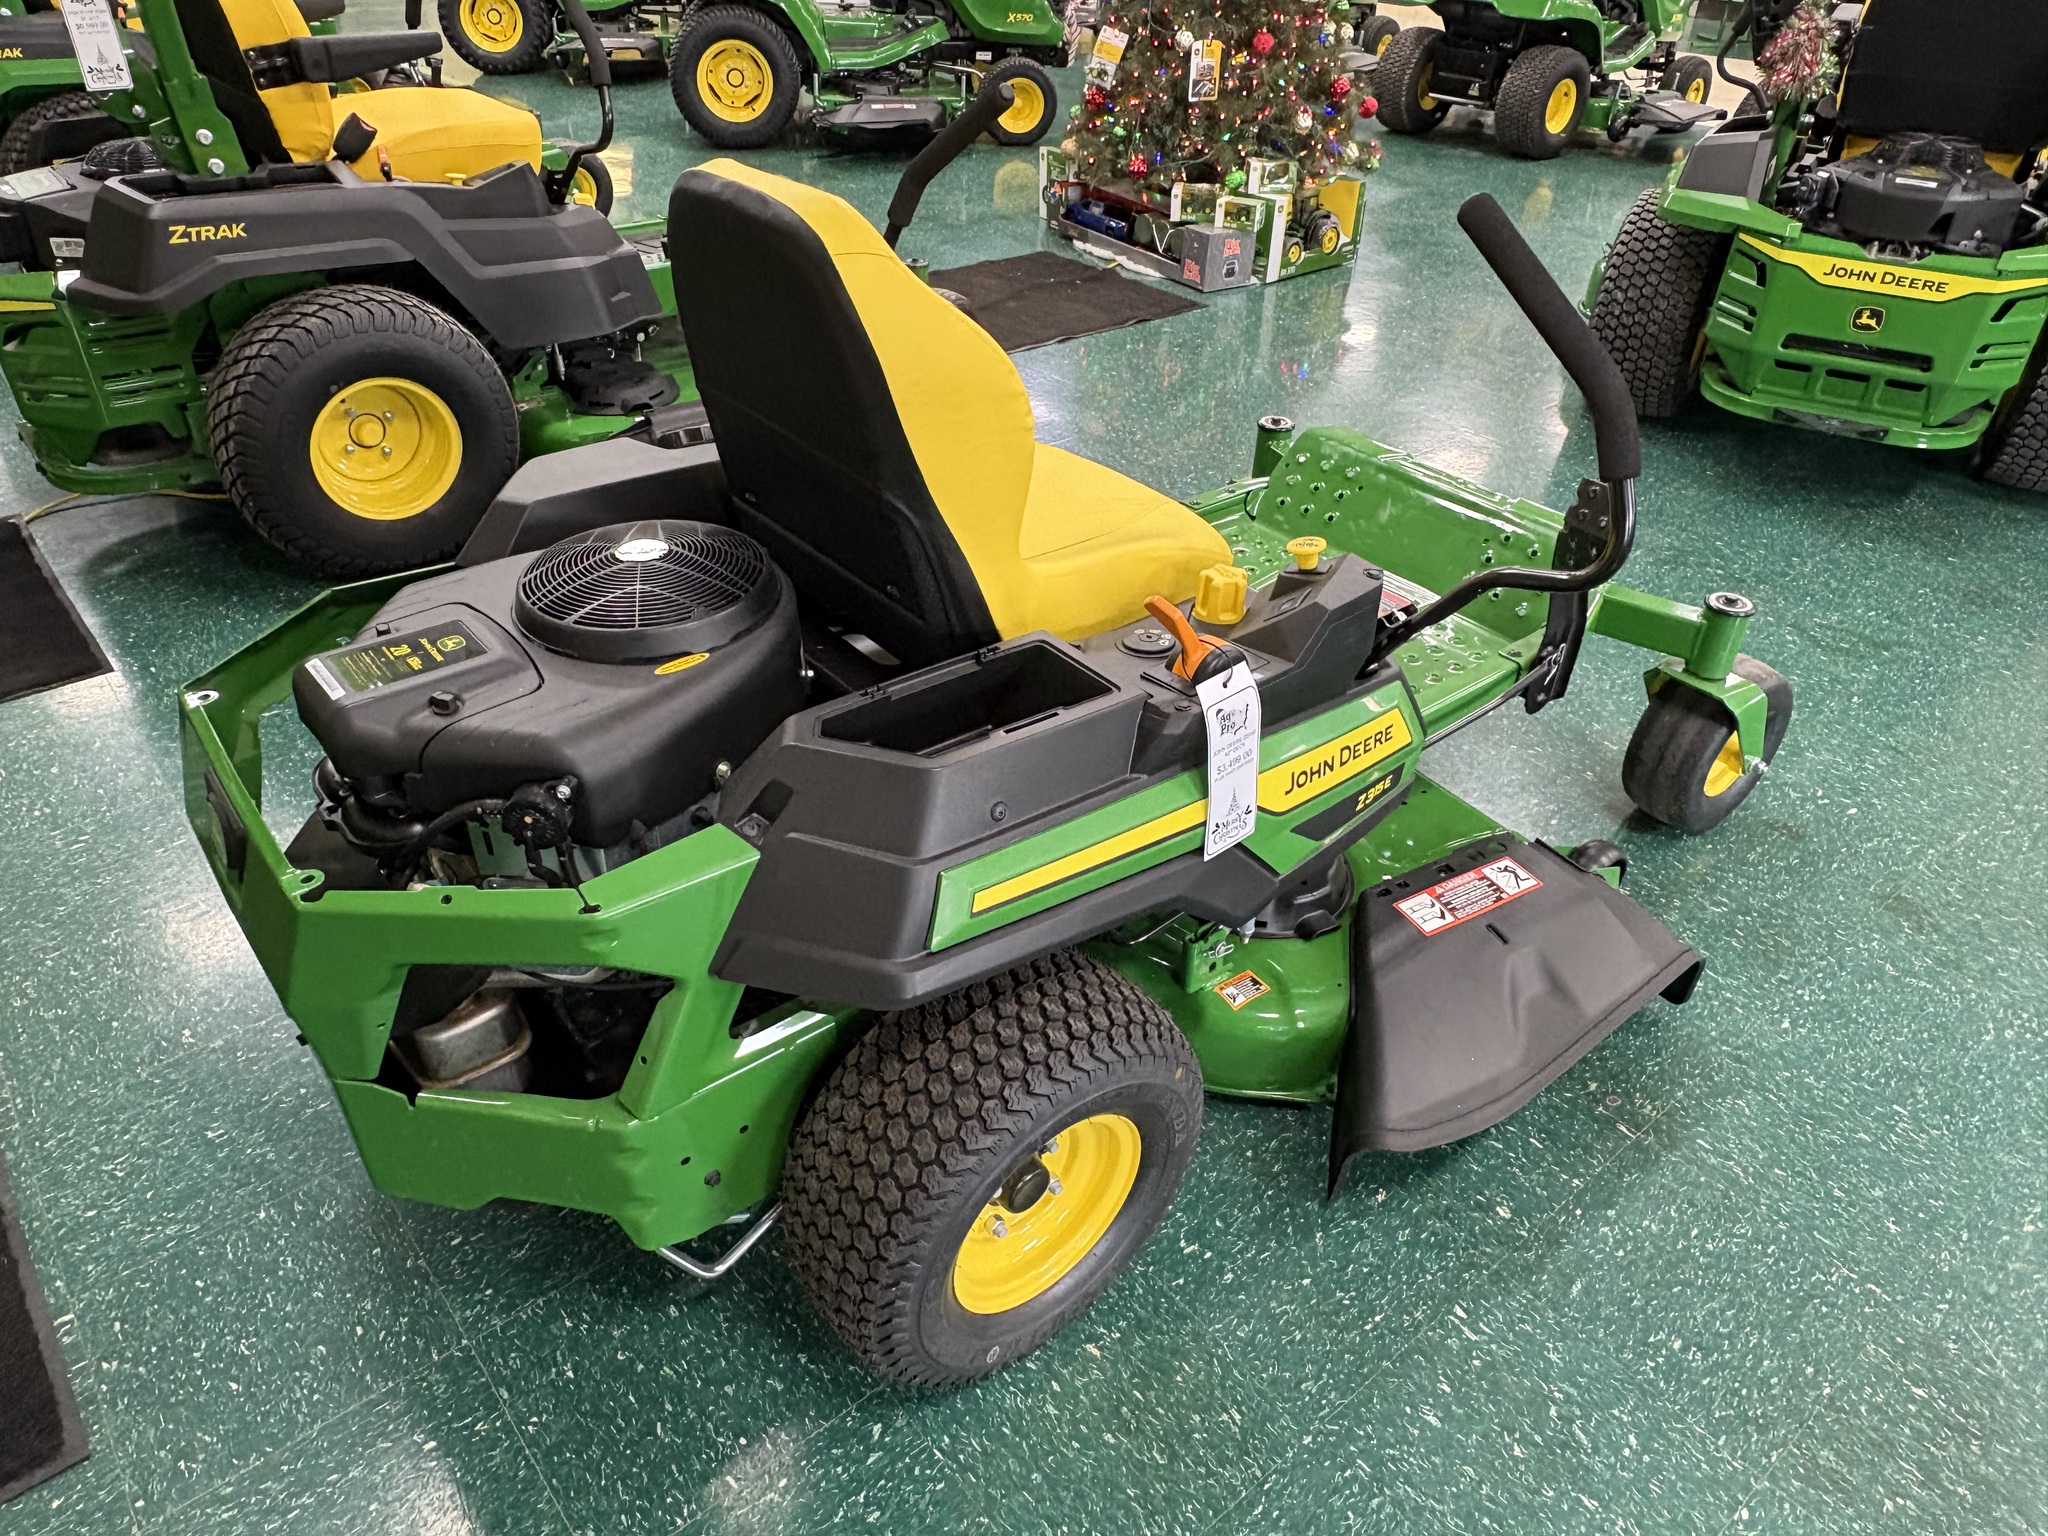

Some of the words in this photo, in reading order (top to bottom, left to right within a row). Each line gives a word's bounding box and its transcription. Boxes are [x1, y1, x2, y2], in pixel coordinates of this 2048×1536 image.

[1007, 12, 1034, 23] X570
[168, 222, 248, 244] ZTRAK
[1823, 263, 1877, 283] JOHN
[1880, 271, 1949, 294] DEERE
[1284, 755, 1335, 796] JOHN
[1339, 723, 1394, 768] DEERE
[1355, 774, 1394, 812] Z315E
